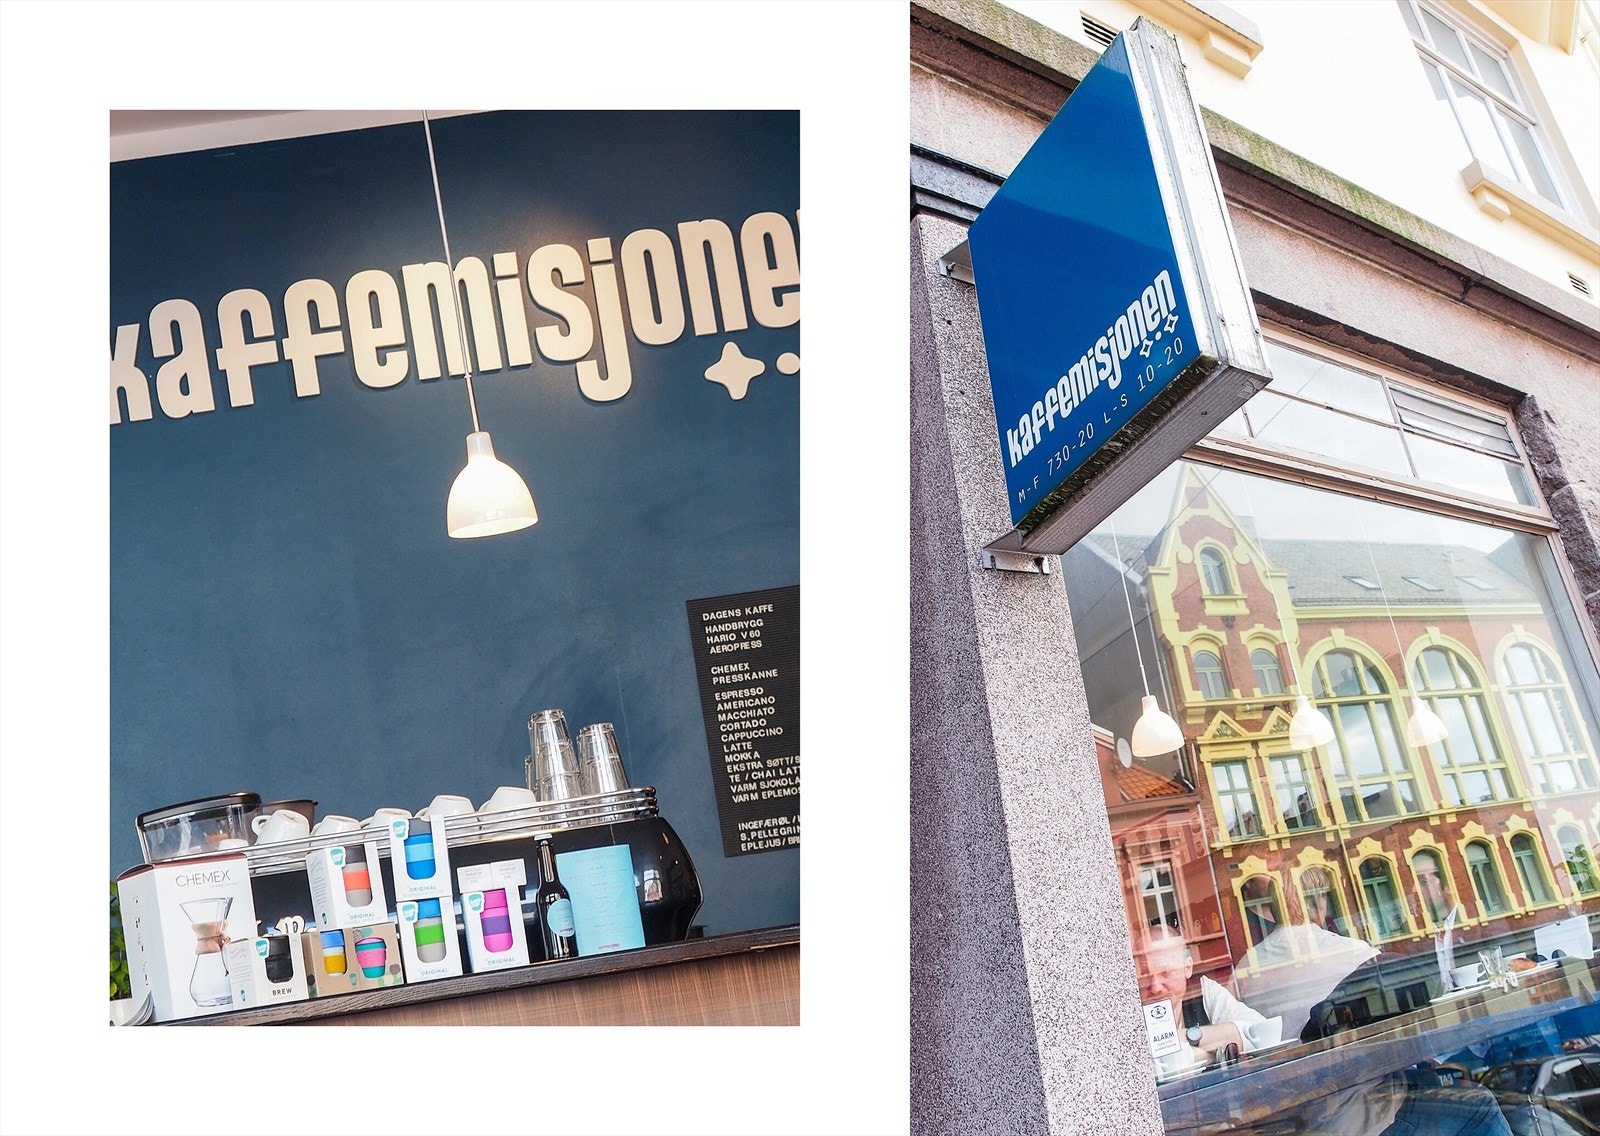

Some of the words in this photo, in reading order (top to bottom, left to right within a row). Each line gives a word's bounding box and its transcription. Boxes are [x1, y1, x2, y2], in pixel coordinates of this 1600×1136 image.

[110, 209, 800, 424] kaffemisjone
[1006, 269, 1177, 468] kaffemisjonen
[1018, 475, 1040, 504] M-F
[1047, 422, 1095, 477] 730-20
[1102, 393, 1129, 425] L-S
[1137, 337, 1184, 393] 10-20
[702, 609, 742, 621] DAGENS
[744, 604, 774, 615] KAFFE
[705, 619, 764, 633] HANDBRYGG
[706, 633, 737, 644] HARIO
[709, 640, 763, 654] AEROPRESS
[710, 662, 750, 674] CHEMEX
[712, 669, 779, 684] PRESSKANNE
[714, 687, 764, 700] ESPRESSO
[716, 696, 776, 711] AMERICANO
[717, 707, 776, 721] MACCHIATO
[720, 719, 767, 731] CORTADO
[721, 727, 784, 742] CAPPUCCINO
[723, 742, 753, 752] LATTE
[725, 751, 760, 762] MOKKA
[726, 762, 763, 772] EKSTRA
[751, 770, 776, 779] CHAI
[779, 765, 800, 775] LAT
[730, 783, 757, 793] VARM
[732, 793, 759, 804] VARM
[175, 869, 231, 888] CHEMEX
[408, 885, 437, 893] ORIGINAL
[349, 912, 376, 920] ORIGINAL
[487, 956, 515, 965] ORIGINAL
[420, 968, 448, 976] ORIGINAL
[272, 987, 293, 997] BREW
[1153, 1032, 1174, 1042] ALARM
